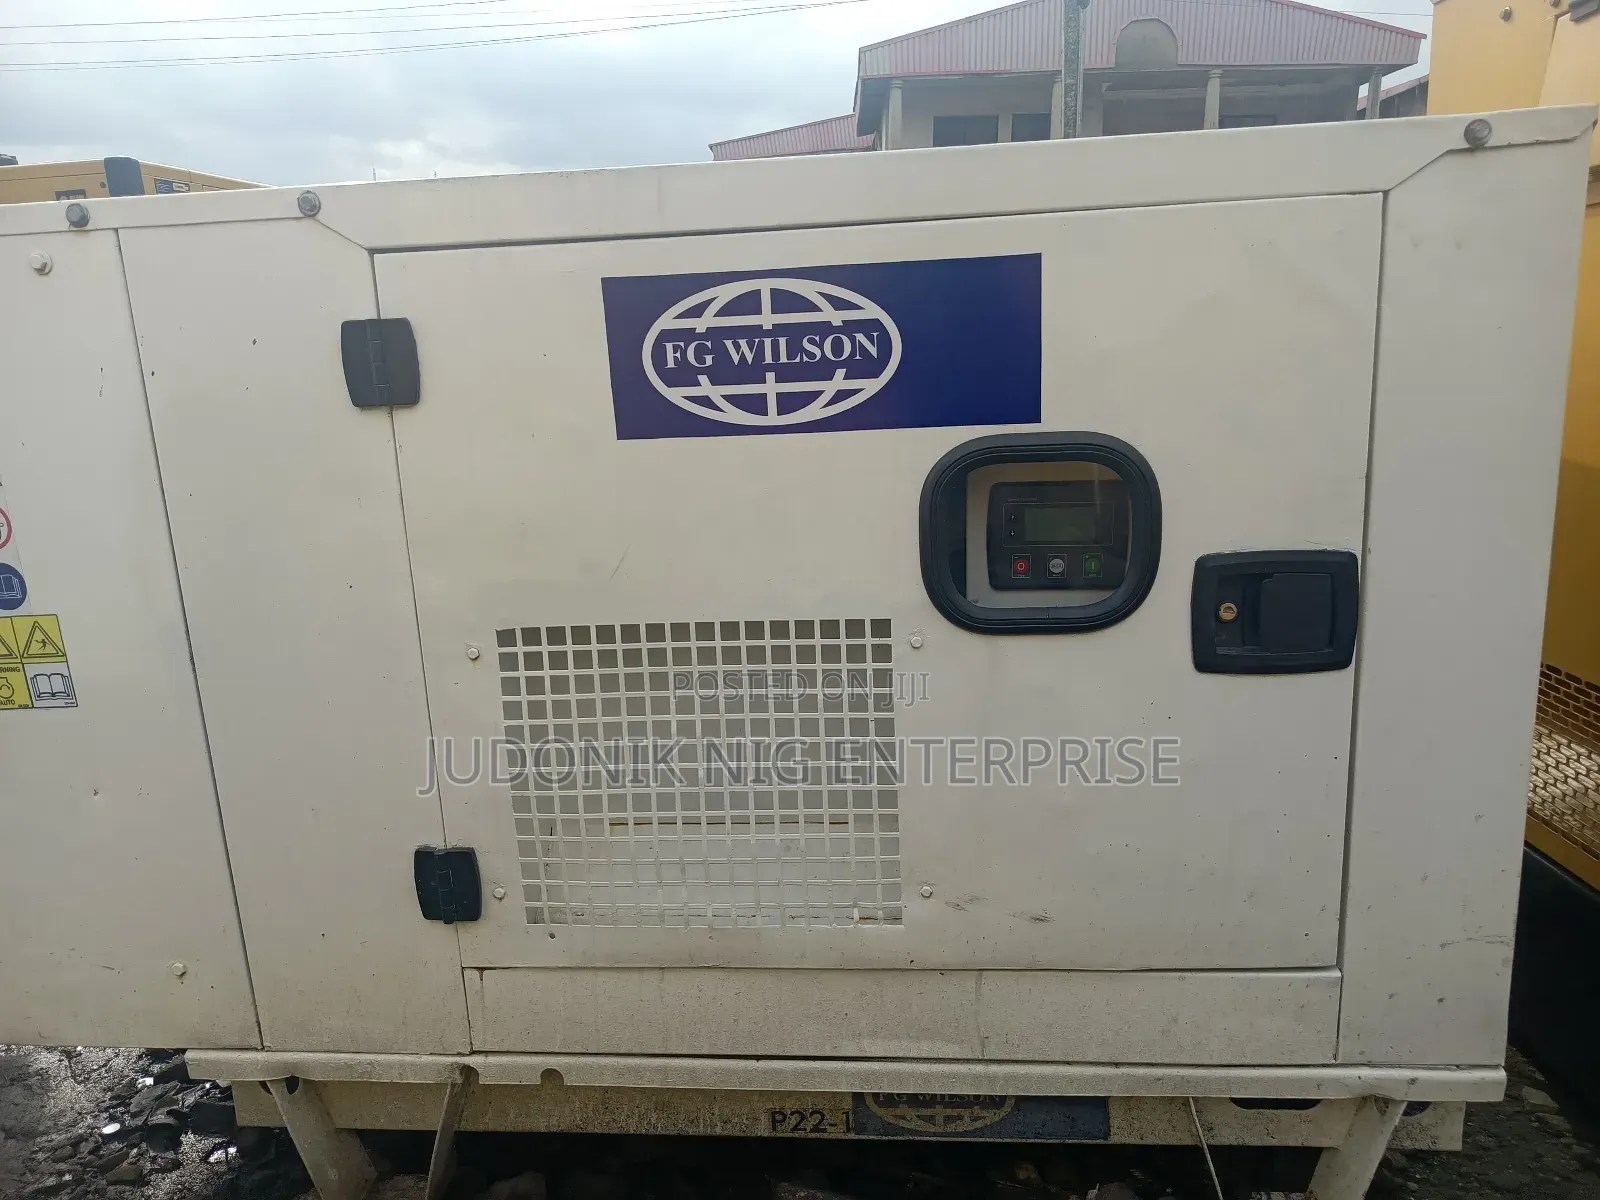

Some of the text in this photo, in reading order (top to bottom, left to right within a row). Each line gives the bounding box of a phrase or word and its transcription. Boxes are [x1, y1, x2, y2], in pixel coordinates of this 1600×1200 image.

[662, 331, 880, 369] FG WILSON
[771, 1109, 851, 1134] P22-1
